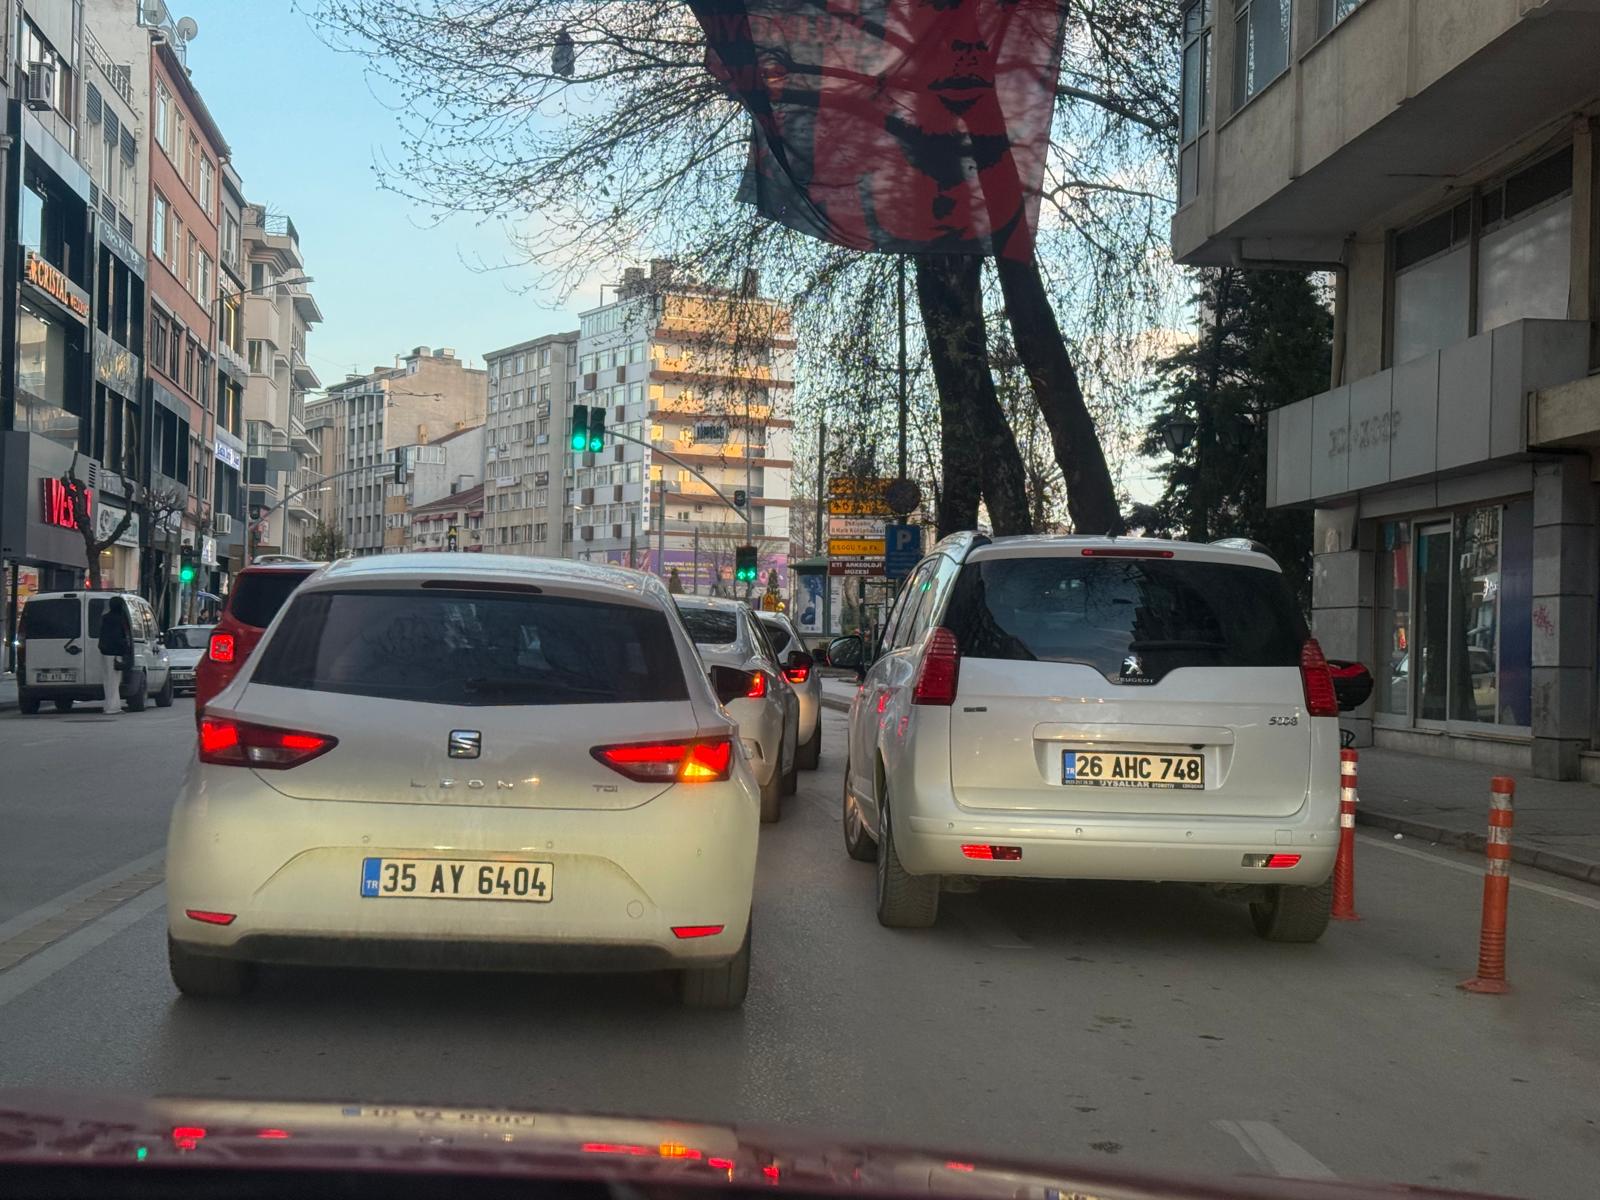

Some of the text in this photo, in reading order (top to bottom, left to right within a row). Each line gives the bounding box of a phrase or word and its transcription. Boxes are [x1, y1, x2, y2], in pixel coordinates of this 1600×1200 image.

[37, 260, 69, 305] CRISTAL
[896, 529, 913, 551] P
[1066, 755, 1200, 781] TR 26 AHC 748
[410, 777, 514, 791] LEON
[592, 784, 618, 793] TDI
[1099, 780, 1149, 789] UYSALLAR
[366, 863, 546, 897] TR 35 AY 6404
